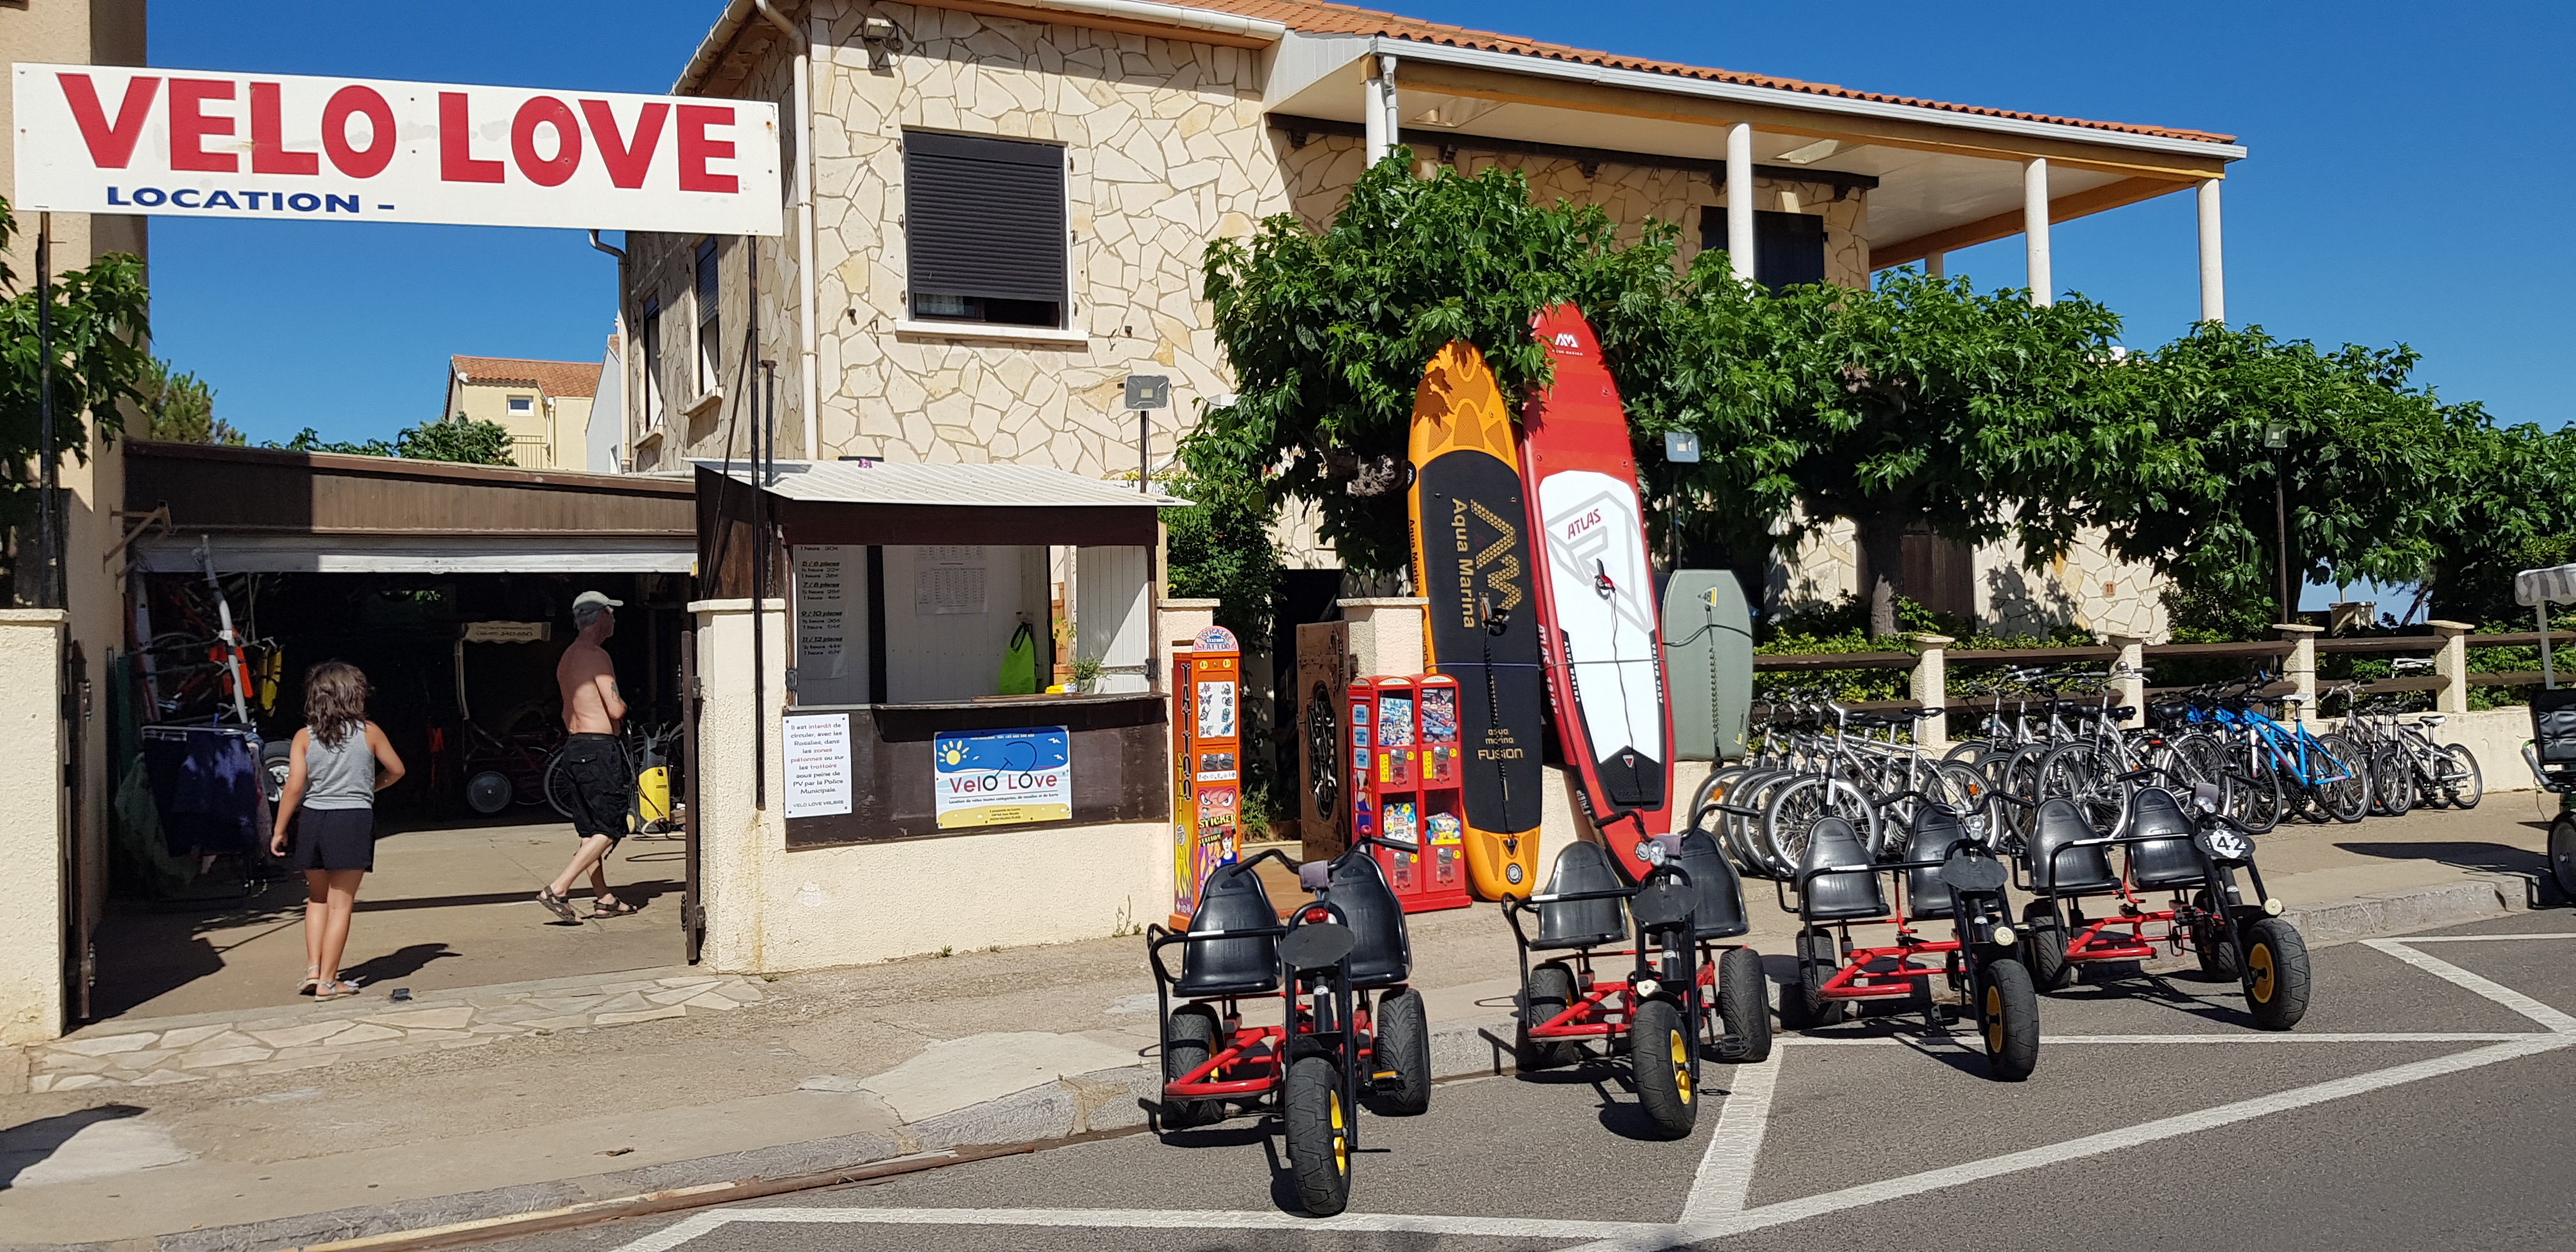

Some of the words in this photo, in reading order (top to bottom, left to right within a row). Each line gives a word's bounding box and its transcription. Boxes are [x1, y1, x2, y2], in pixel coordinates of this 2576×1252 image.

[56, 72, 396, 178] VELO
[438, 92, 739, 194] LOVE
[107, 186, 360, 213] LOCATION
[1452, 498, 1468, 552] Aqua
[1568, 508, 1601, 540] ATLAS
[1411, 552, 1420, 592] Marina
[1458, 559, 1476, 628] Marina
[1570, 668, 1580, 702] MARINA
[1199, 813, 1236, 828] STICKER
